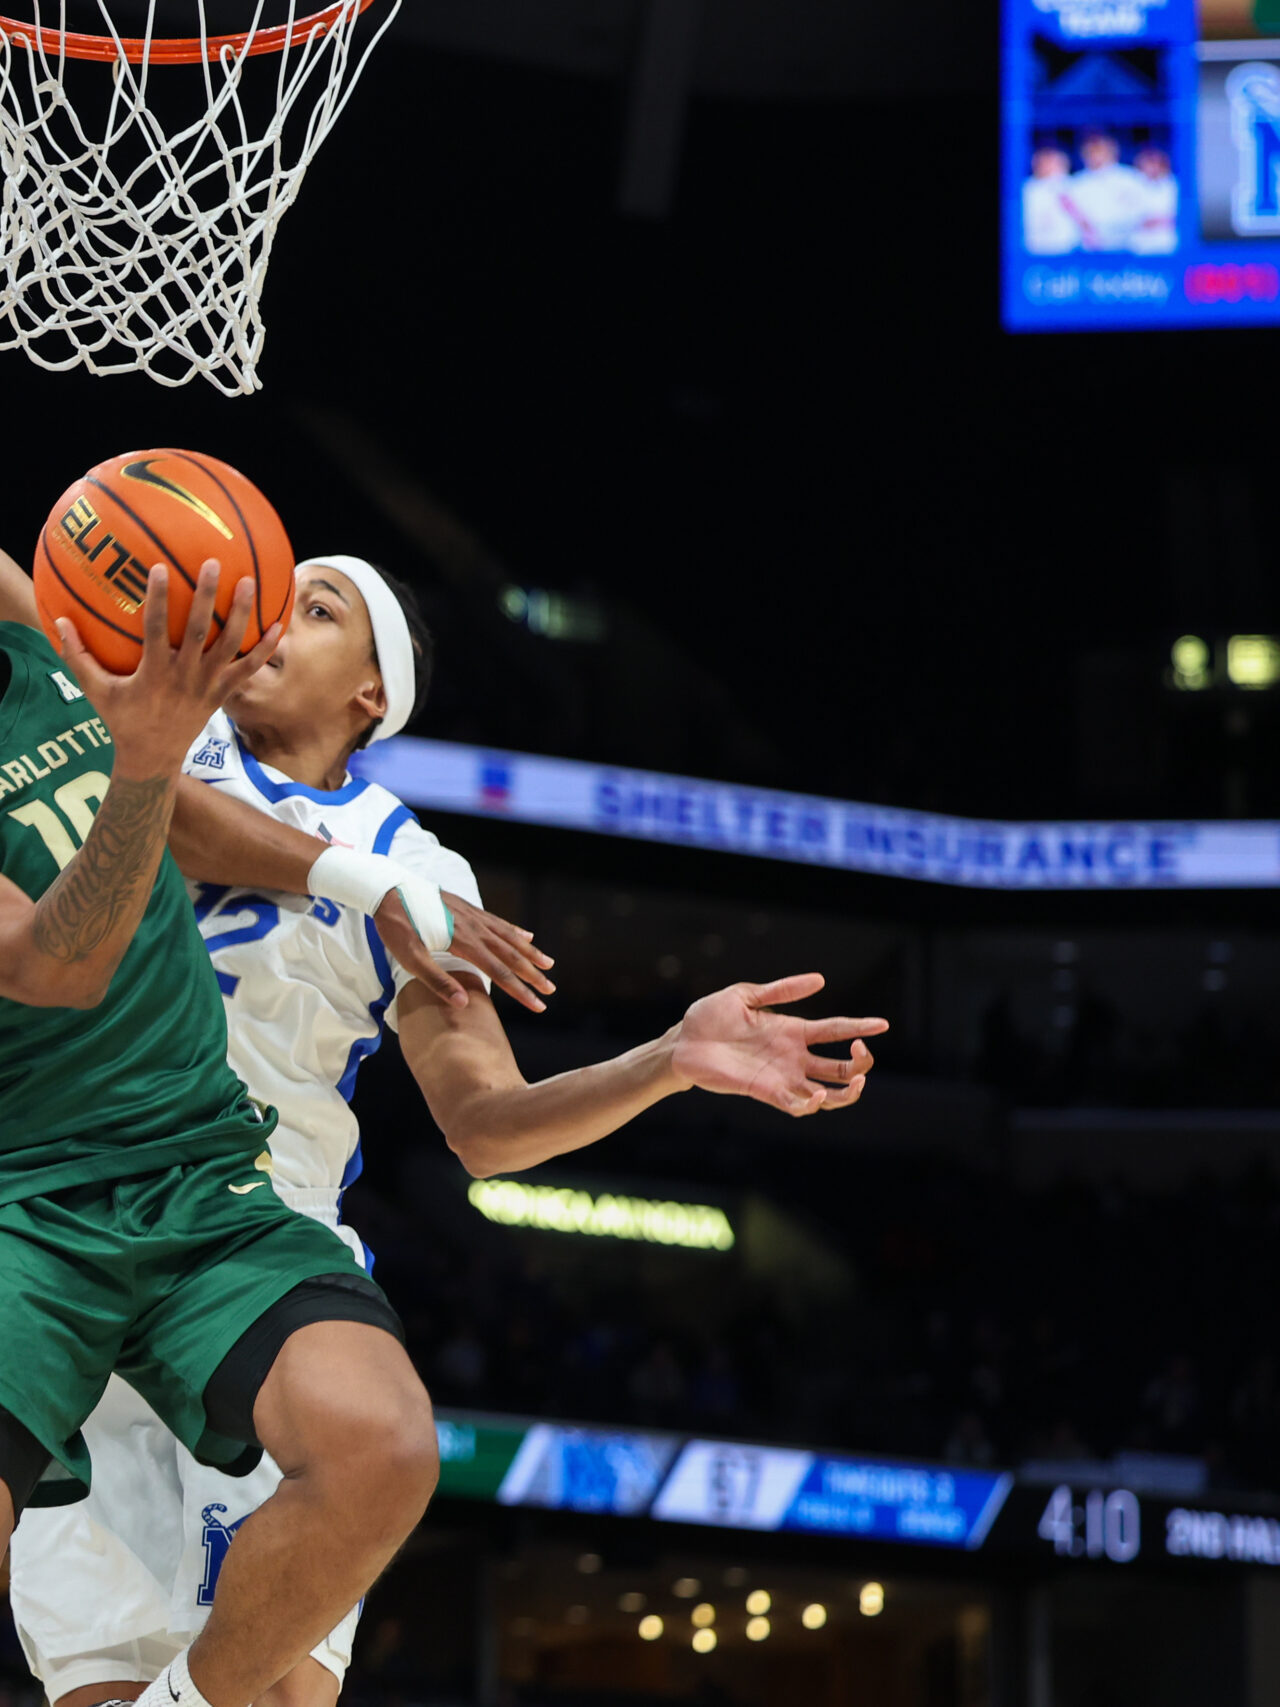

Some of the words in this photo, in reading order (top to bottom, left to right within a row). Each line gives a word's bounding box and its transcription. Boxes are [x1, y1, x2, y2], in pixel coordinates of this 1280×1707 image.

[60, 495, 149, 607] ELITE
[593, 776, 829, 848] SHELTER
[845, 814, 1182, 877] INSURANCE
[1038, 1485, 1140, 1562] 4:10
